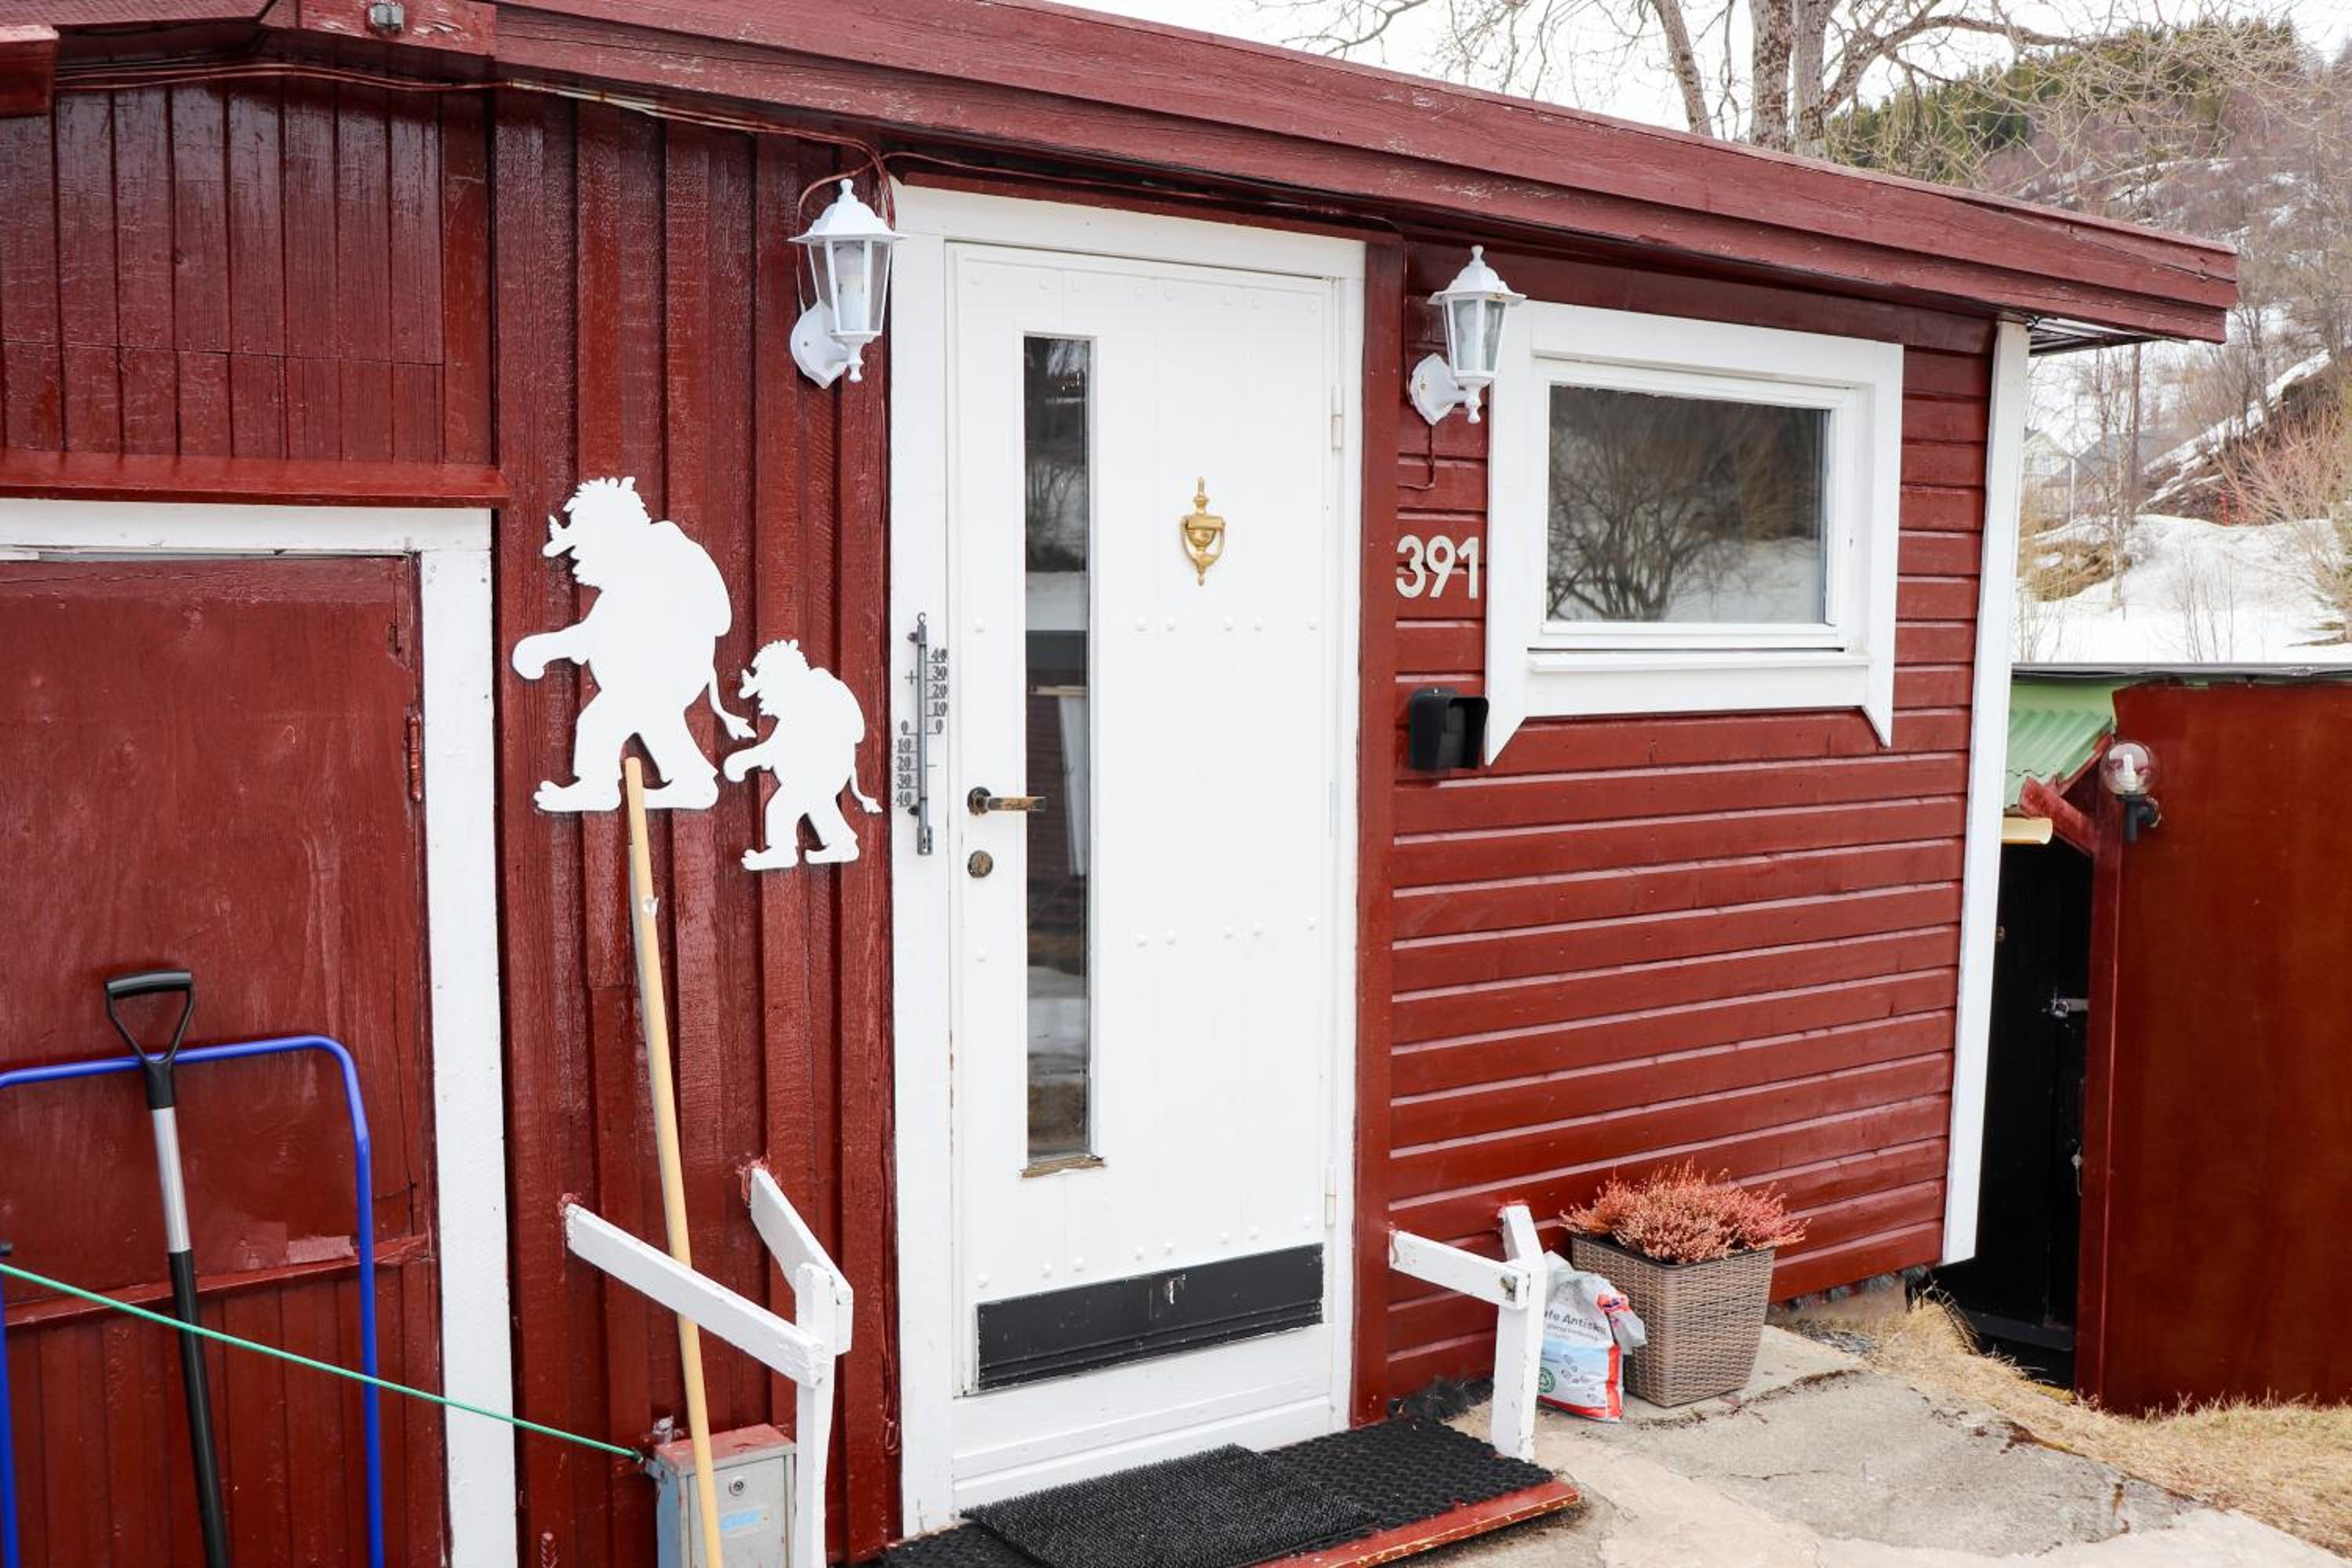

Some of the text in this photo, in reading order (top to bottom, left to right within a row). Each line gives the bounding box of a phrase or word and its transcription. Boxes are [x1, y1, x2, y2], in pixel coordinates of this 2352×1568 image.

[1396, 535, 1479, 599] 391
[931, 648, 947, 662] 40
[931, 665, 947, 680] 30
[932, 683, 947, 698] 20
[933, 702, 947, 717] 10
[898, 739, 911, 753] 10
[896, 756, 911, 771] 20
[896, 773, 911, 789] 30
[896, 791, 911, 807] 40
